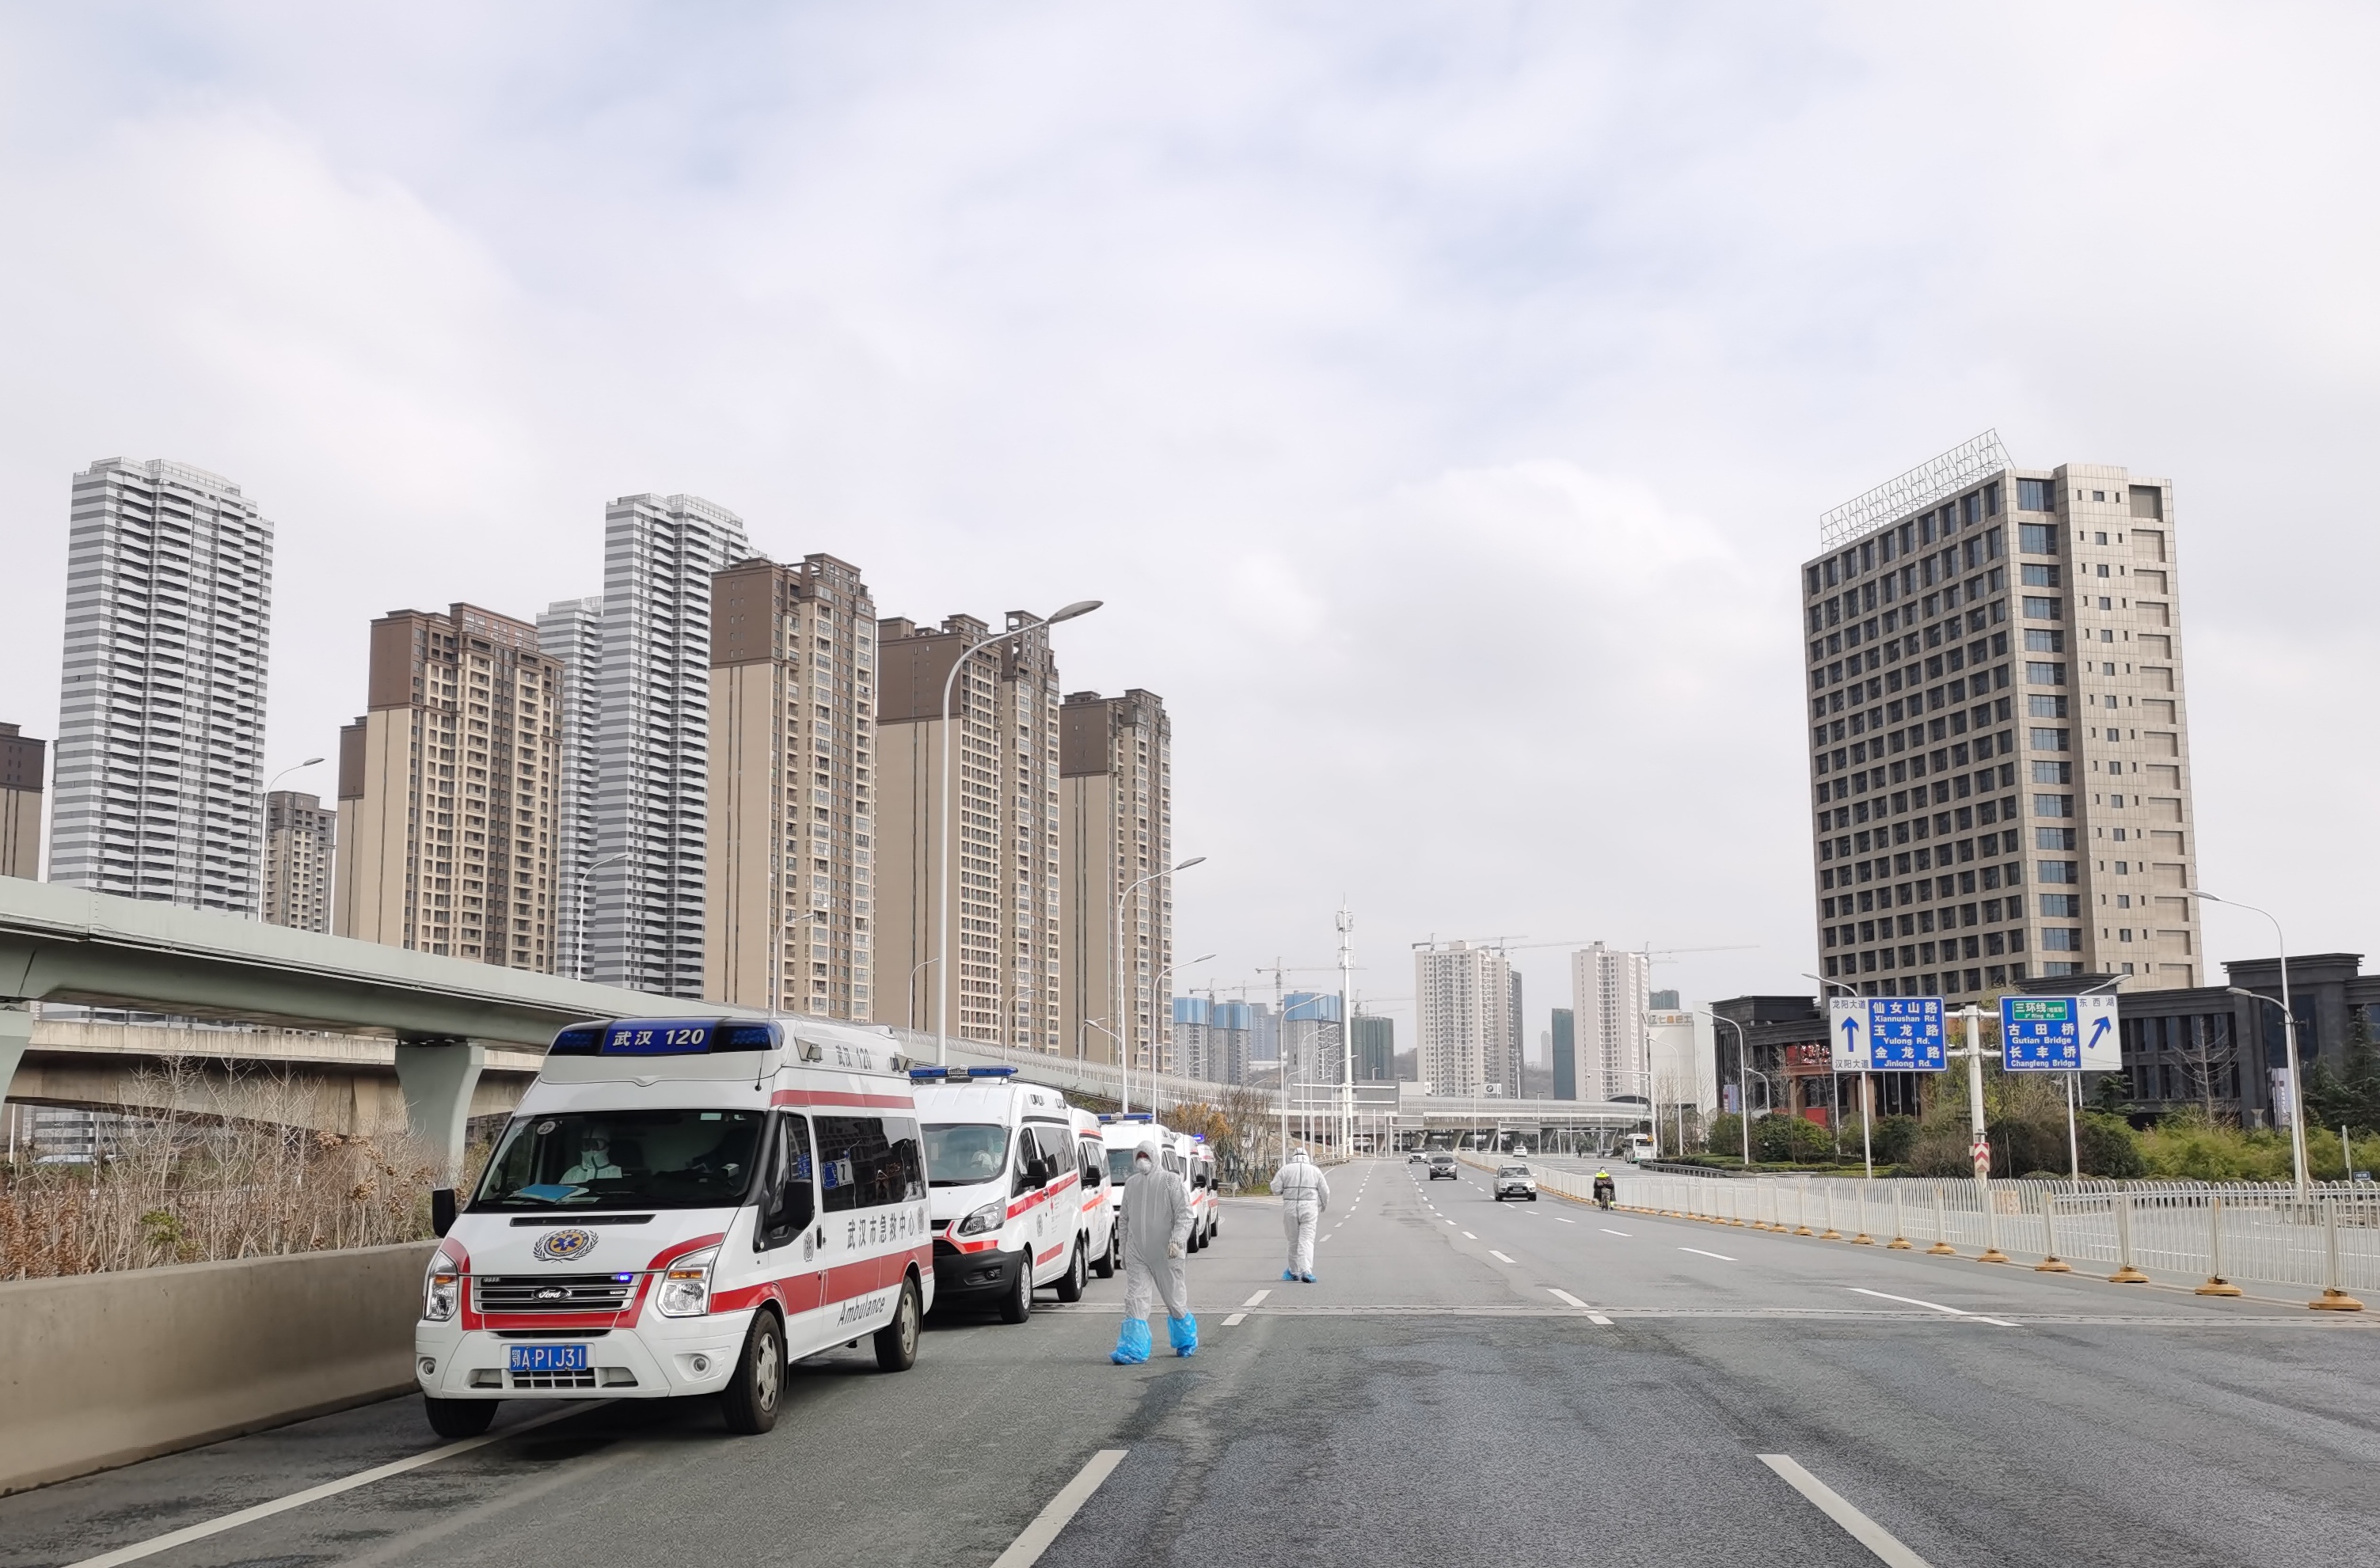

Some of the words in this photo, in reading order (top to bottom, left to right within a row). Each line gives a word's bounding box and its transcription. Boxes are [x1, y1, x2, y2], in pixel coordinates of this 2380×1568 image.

[1832, 1000, 1866, 1009] 龙阳大道
[1872, 1001, 1938, 1014] 仙女山路
[2015, 1002, 2047, 1013] 三环线
[2078, 997, 2115, 1008] 东西湖
[1873, 1024, 1939, 1037] 玉龙路
[2007, 1023, 2075, 1036] 古田桥
[613, 1031, 653, 1046] 武汉
[665, 1028, 705, 1045] 120
[1883, 1037, 1912, 1046] Yulong
[2044, 1036, 2072, 1045] Bridge
[835, 1045, 853, 1068] 武汉
[856, 1047, 872, 1069] 120
[1875, 1046, 1940, 1059] 金龙路
[2009, 1046, 2076, 1058] 长丰桥
[1834, 1059, 1869, 1069] 汉阳大道
[2011, 1059, 2049, 1068] Changfeng
[847, 1210, 915, 1250] 武汉市急救中心
[538, 1289, 561, 1300] Ford
[837, 1295, 885, 1327] Ambulance
